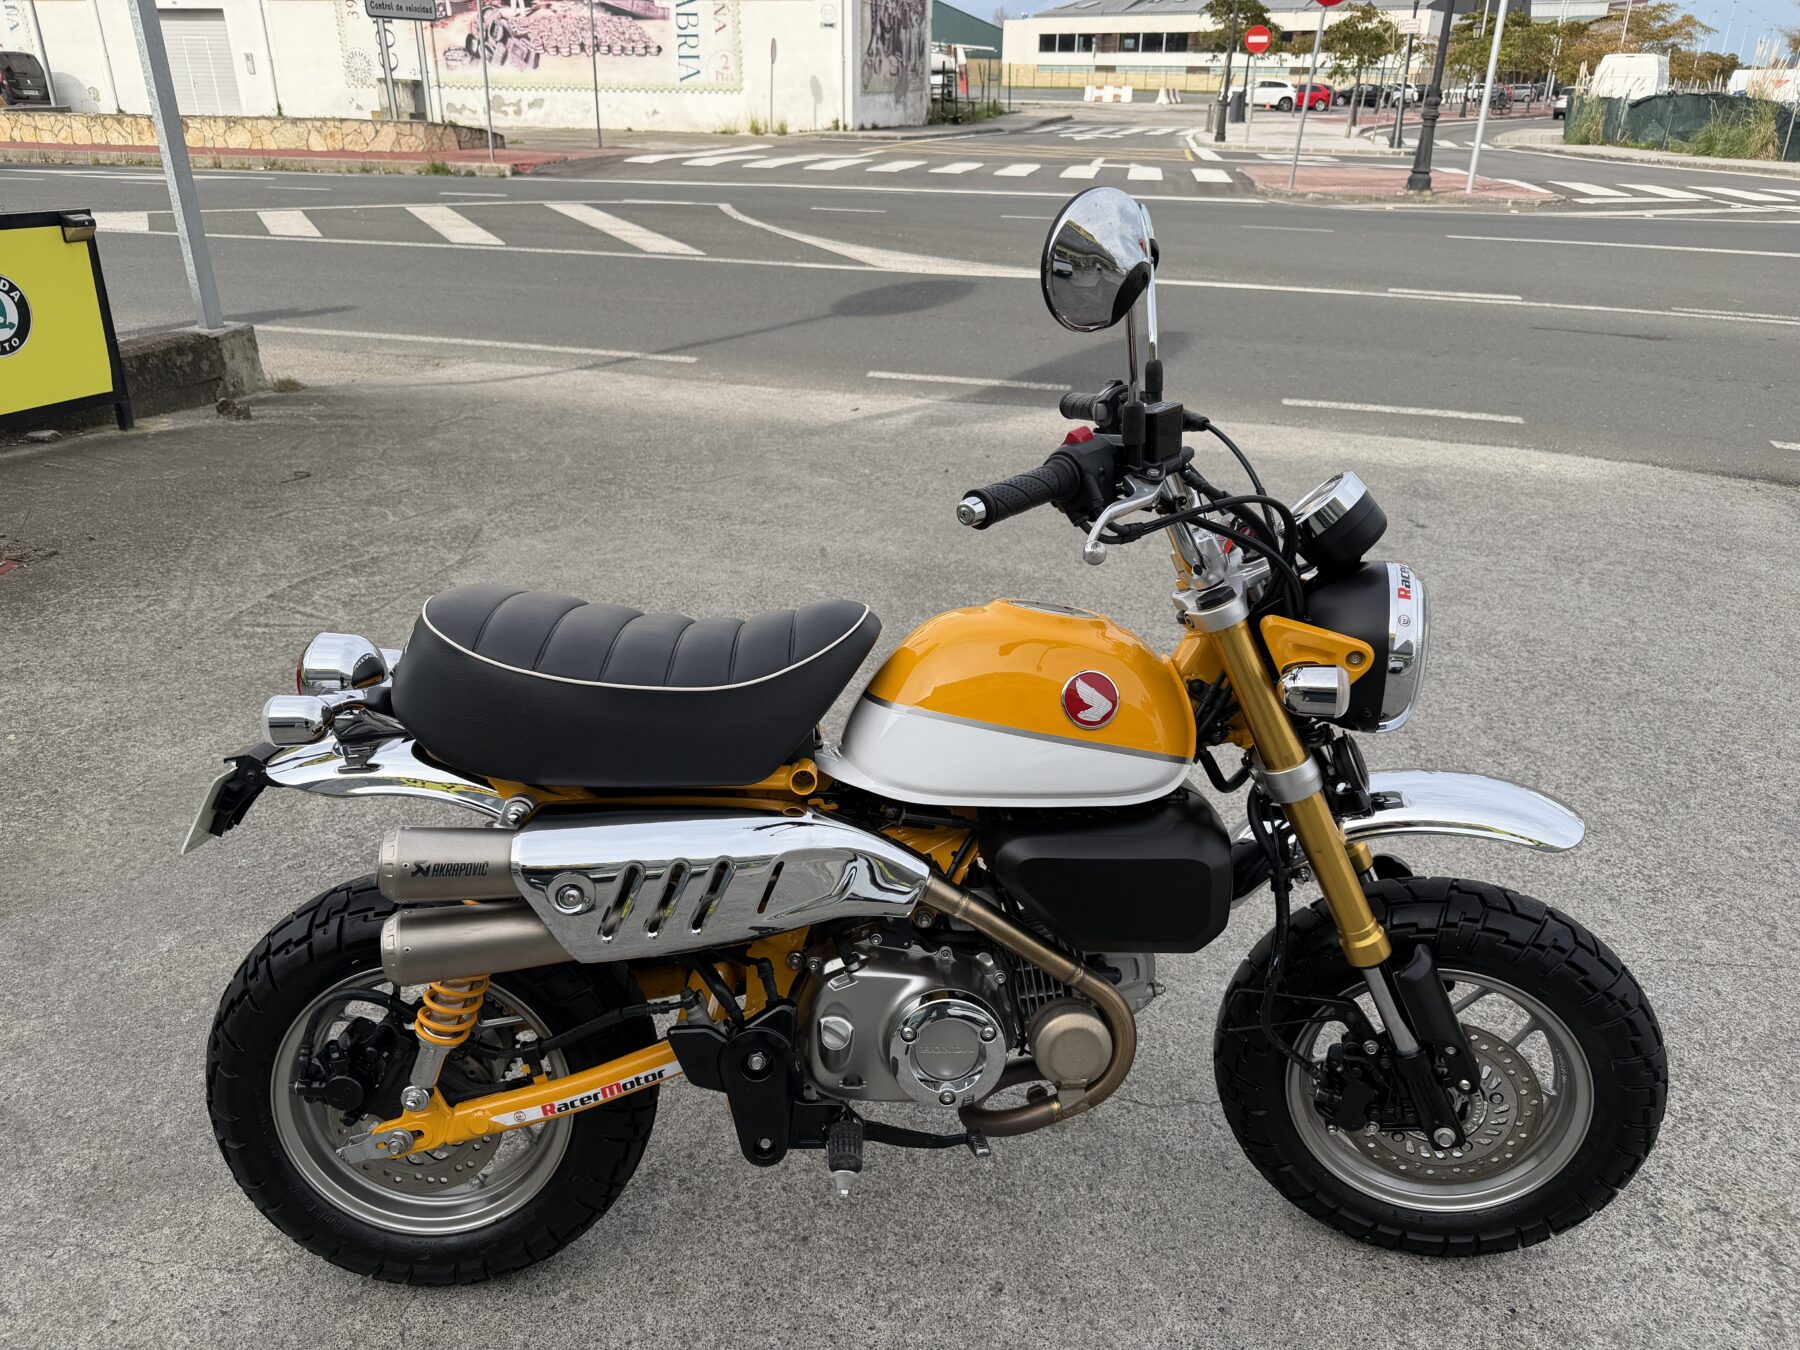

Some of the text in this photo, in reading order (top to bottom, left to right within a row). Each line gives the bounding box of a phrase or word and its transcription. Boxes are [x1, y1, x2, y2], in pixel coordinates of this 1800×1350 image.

[369, 1, 433, 14] Control de velocidad
[920, 1045, 975, 1054] HONDA
[541, 1069, 666, 1116] RacerMotor
